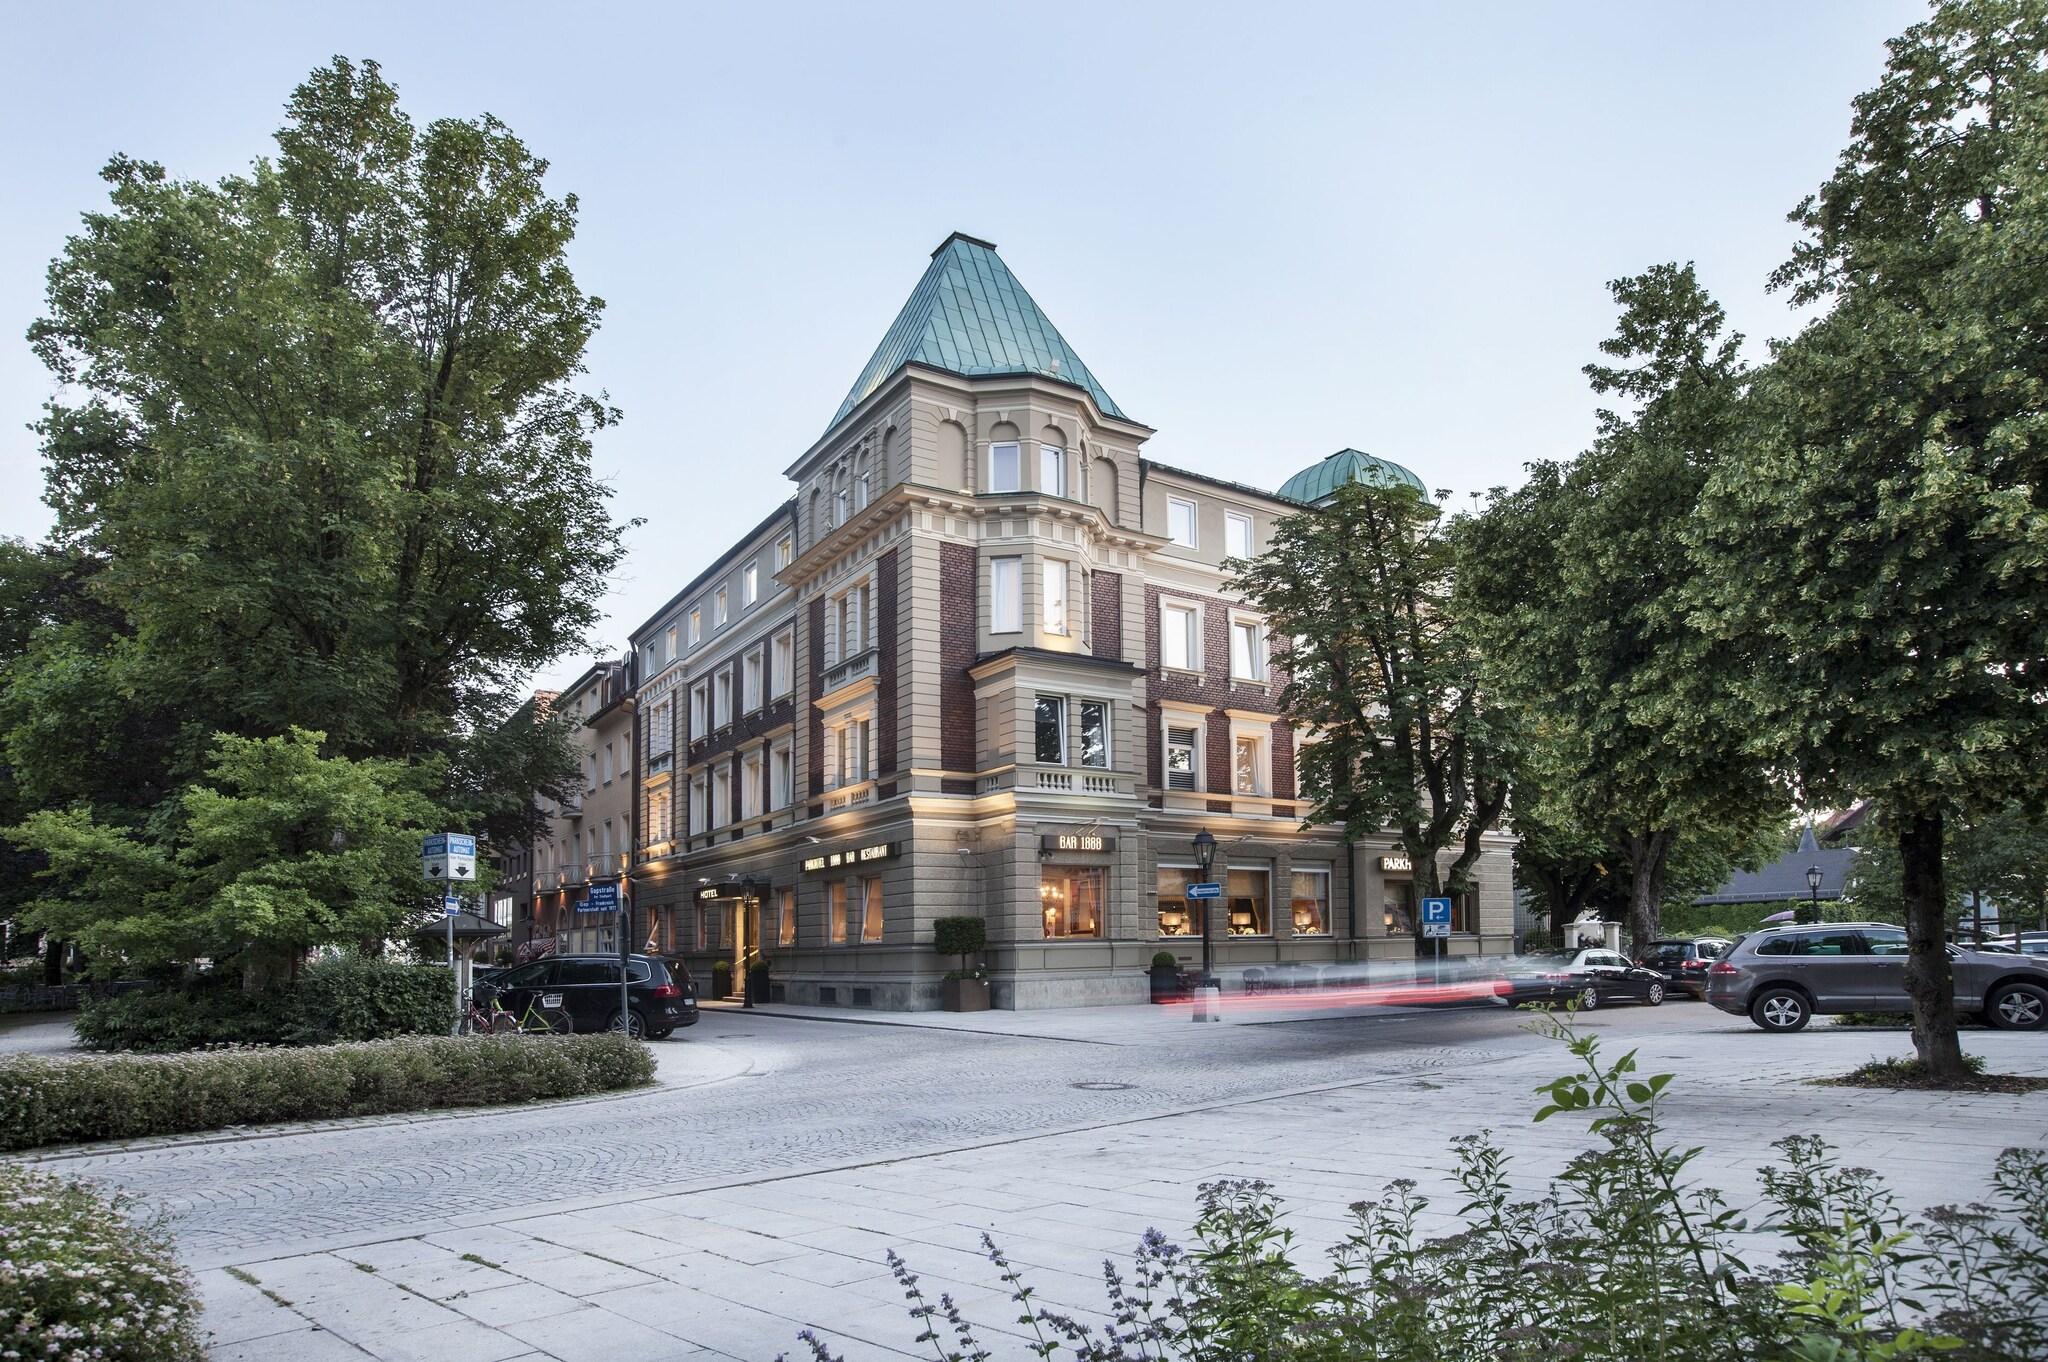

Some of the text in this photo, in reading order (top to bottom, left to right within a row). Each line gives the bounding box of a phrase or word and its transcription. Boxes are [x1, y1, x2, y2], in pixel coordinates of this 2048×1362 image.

[1060, 836, 1102, 850] BAR 1888
[846, 851, 856, 864] BAR
[861, 844, 888, 861] RESTAURANT
[700, 889, 718, 899] HOTEL
[1429, 901, 1445, 921] P
